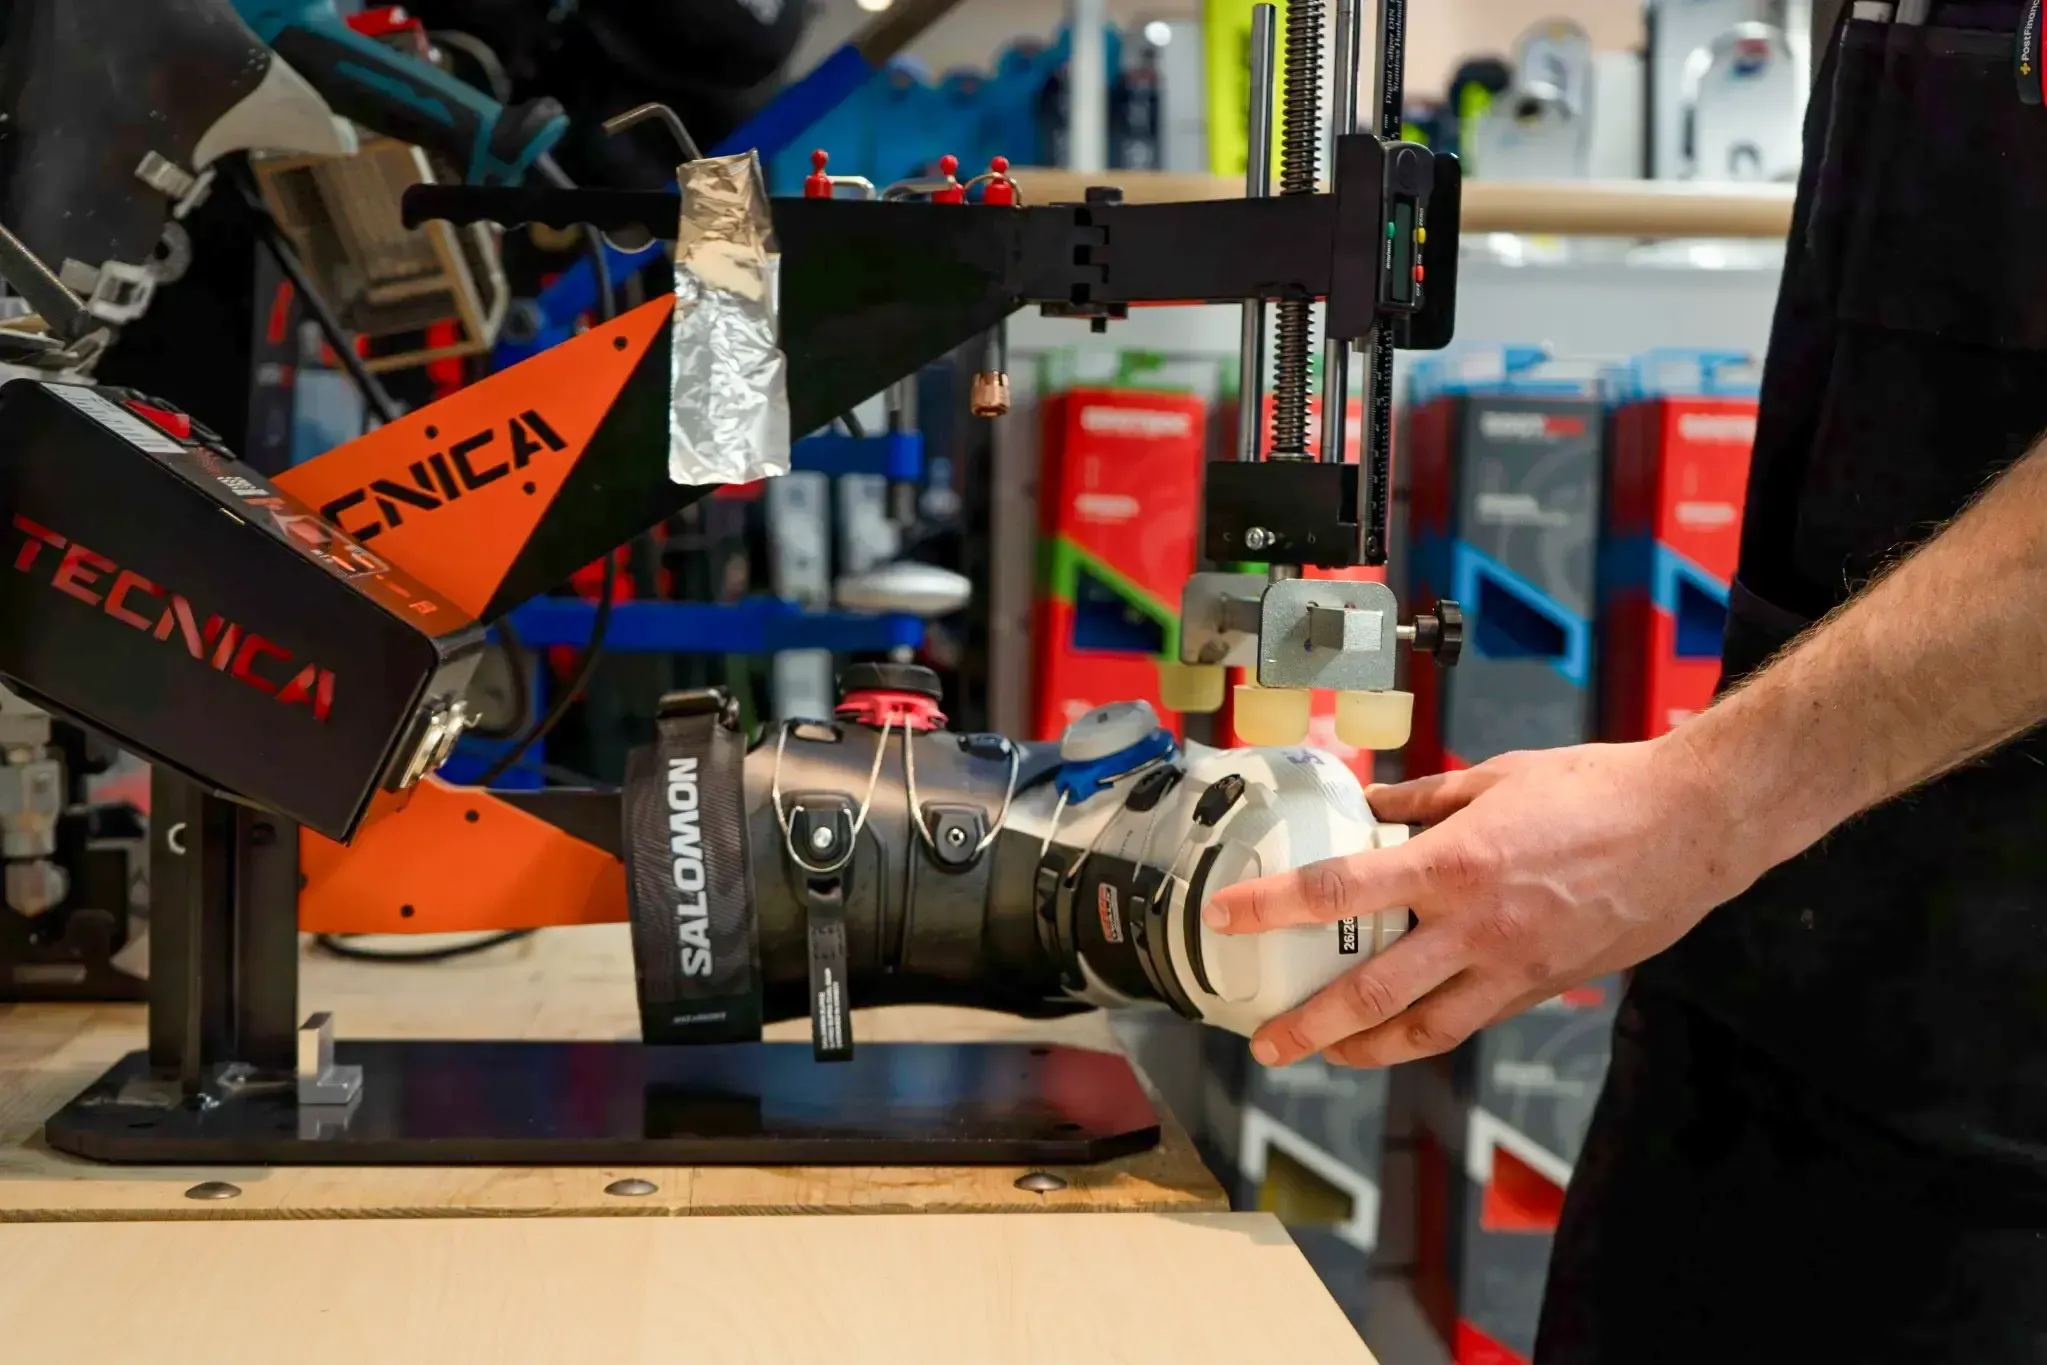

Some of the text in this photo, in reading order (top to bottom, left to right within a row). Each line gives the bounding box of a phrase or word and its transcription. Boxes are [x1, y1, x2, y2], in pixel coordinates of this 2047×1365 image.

[1387, 32, 1395, 68] Caliper
[12, 515, 336, 723] TECNICA
[668, 757, 712, 977] SALOMON
